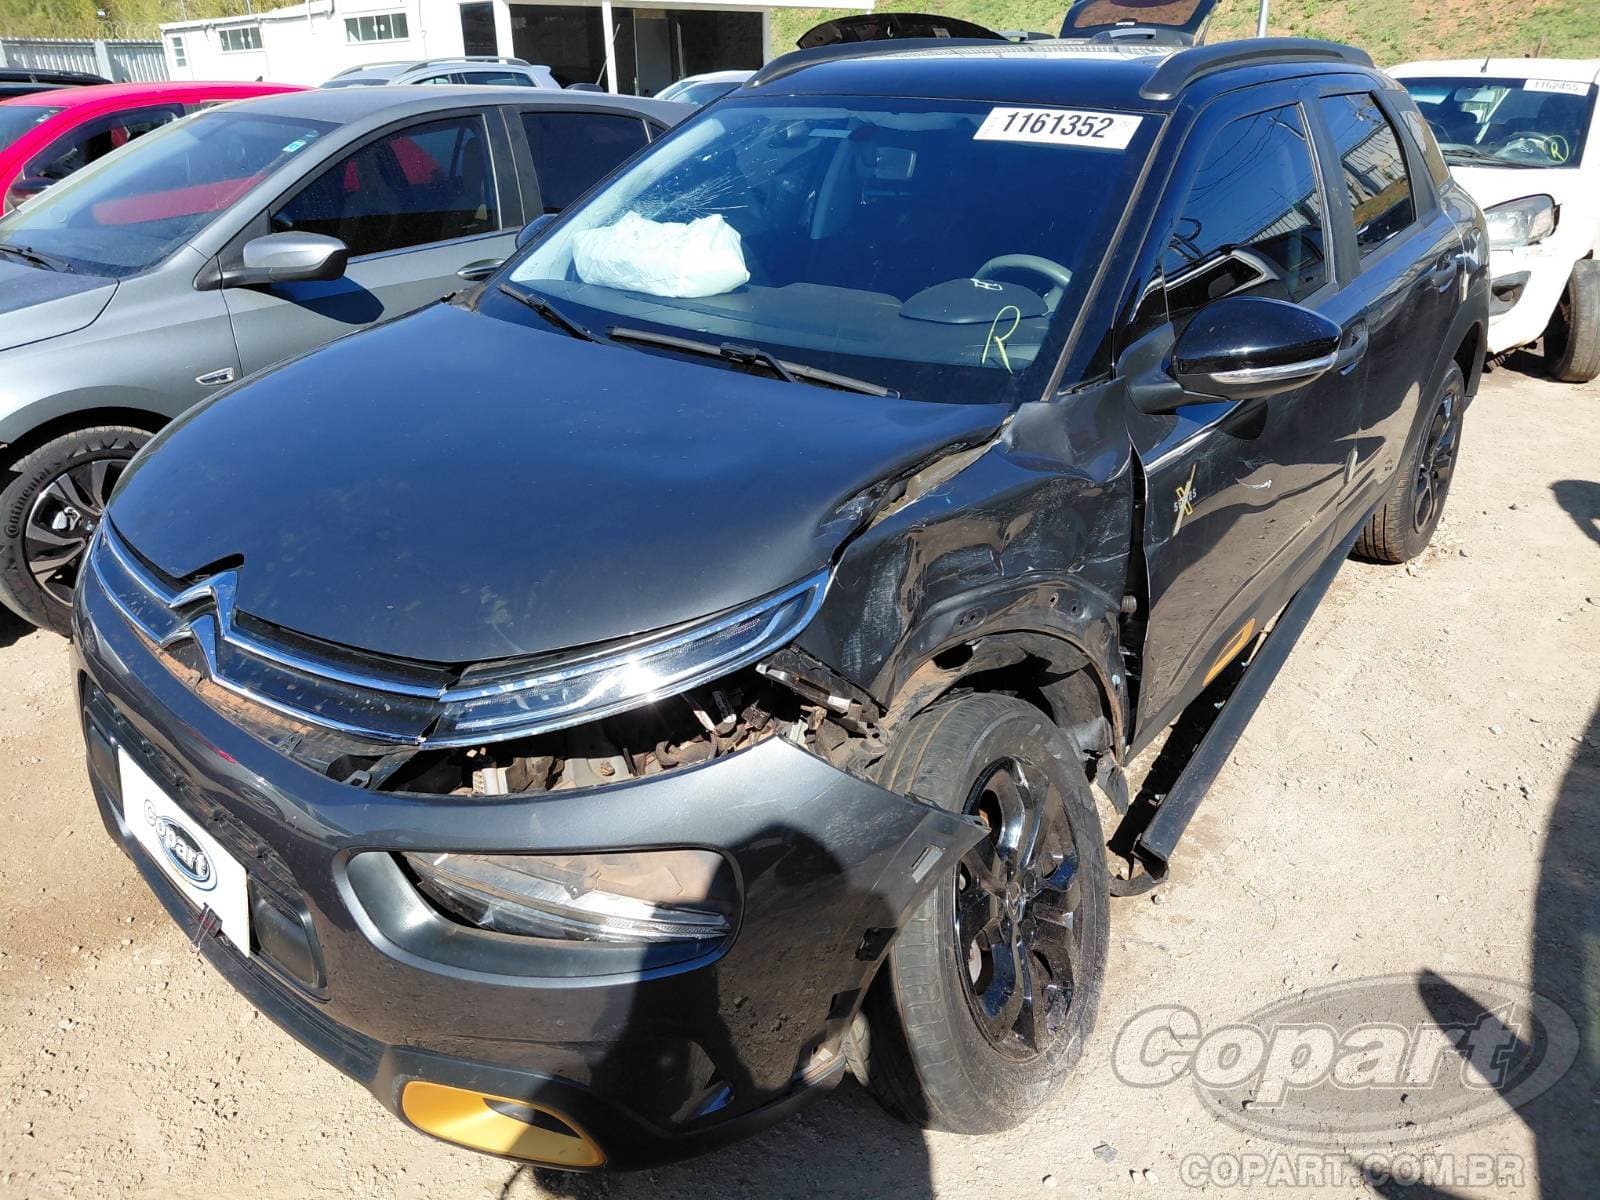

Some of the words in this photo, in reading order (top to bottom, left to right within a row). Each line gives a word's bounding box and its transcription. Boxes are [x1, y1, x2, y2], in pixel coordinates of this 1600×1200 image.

[1003, 111, 1114, 138] 1161352
[981, 305, 1020, 374] R
[4, 467, 51, 539] Continental
[143, 799, 210, 878] Copart
